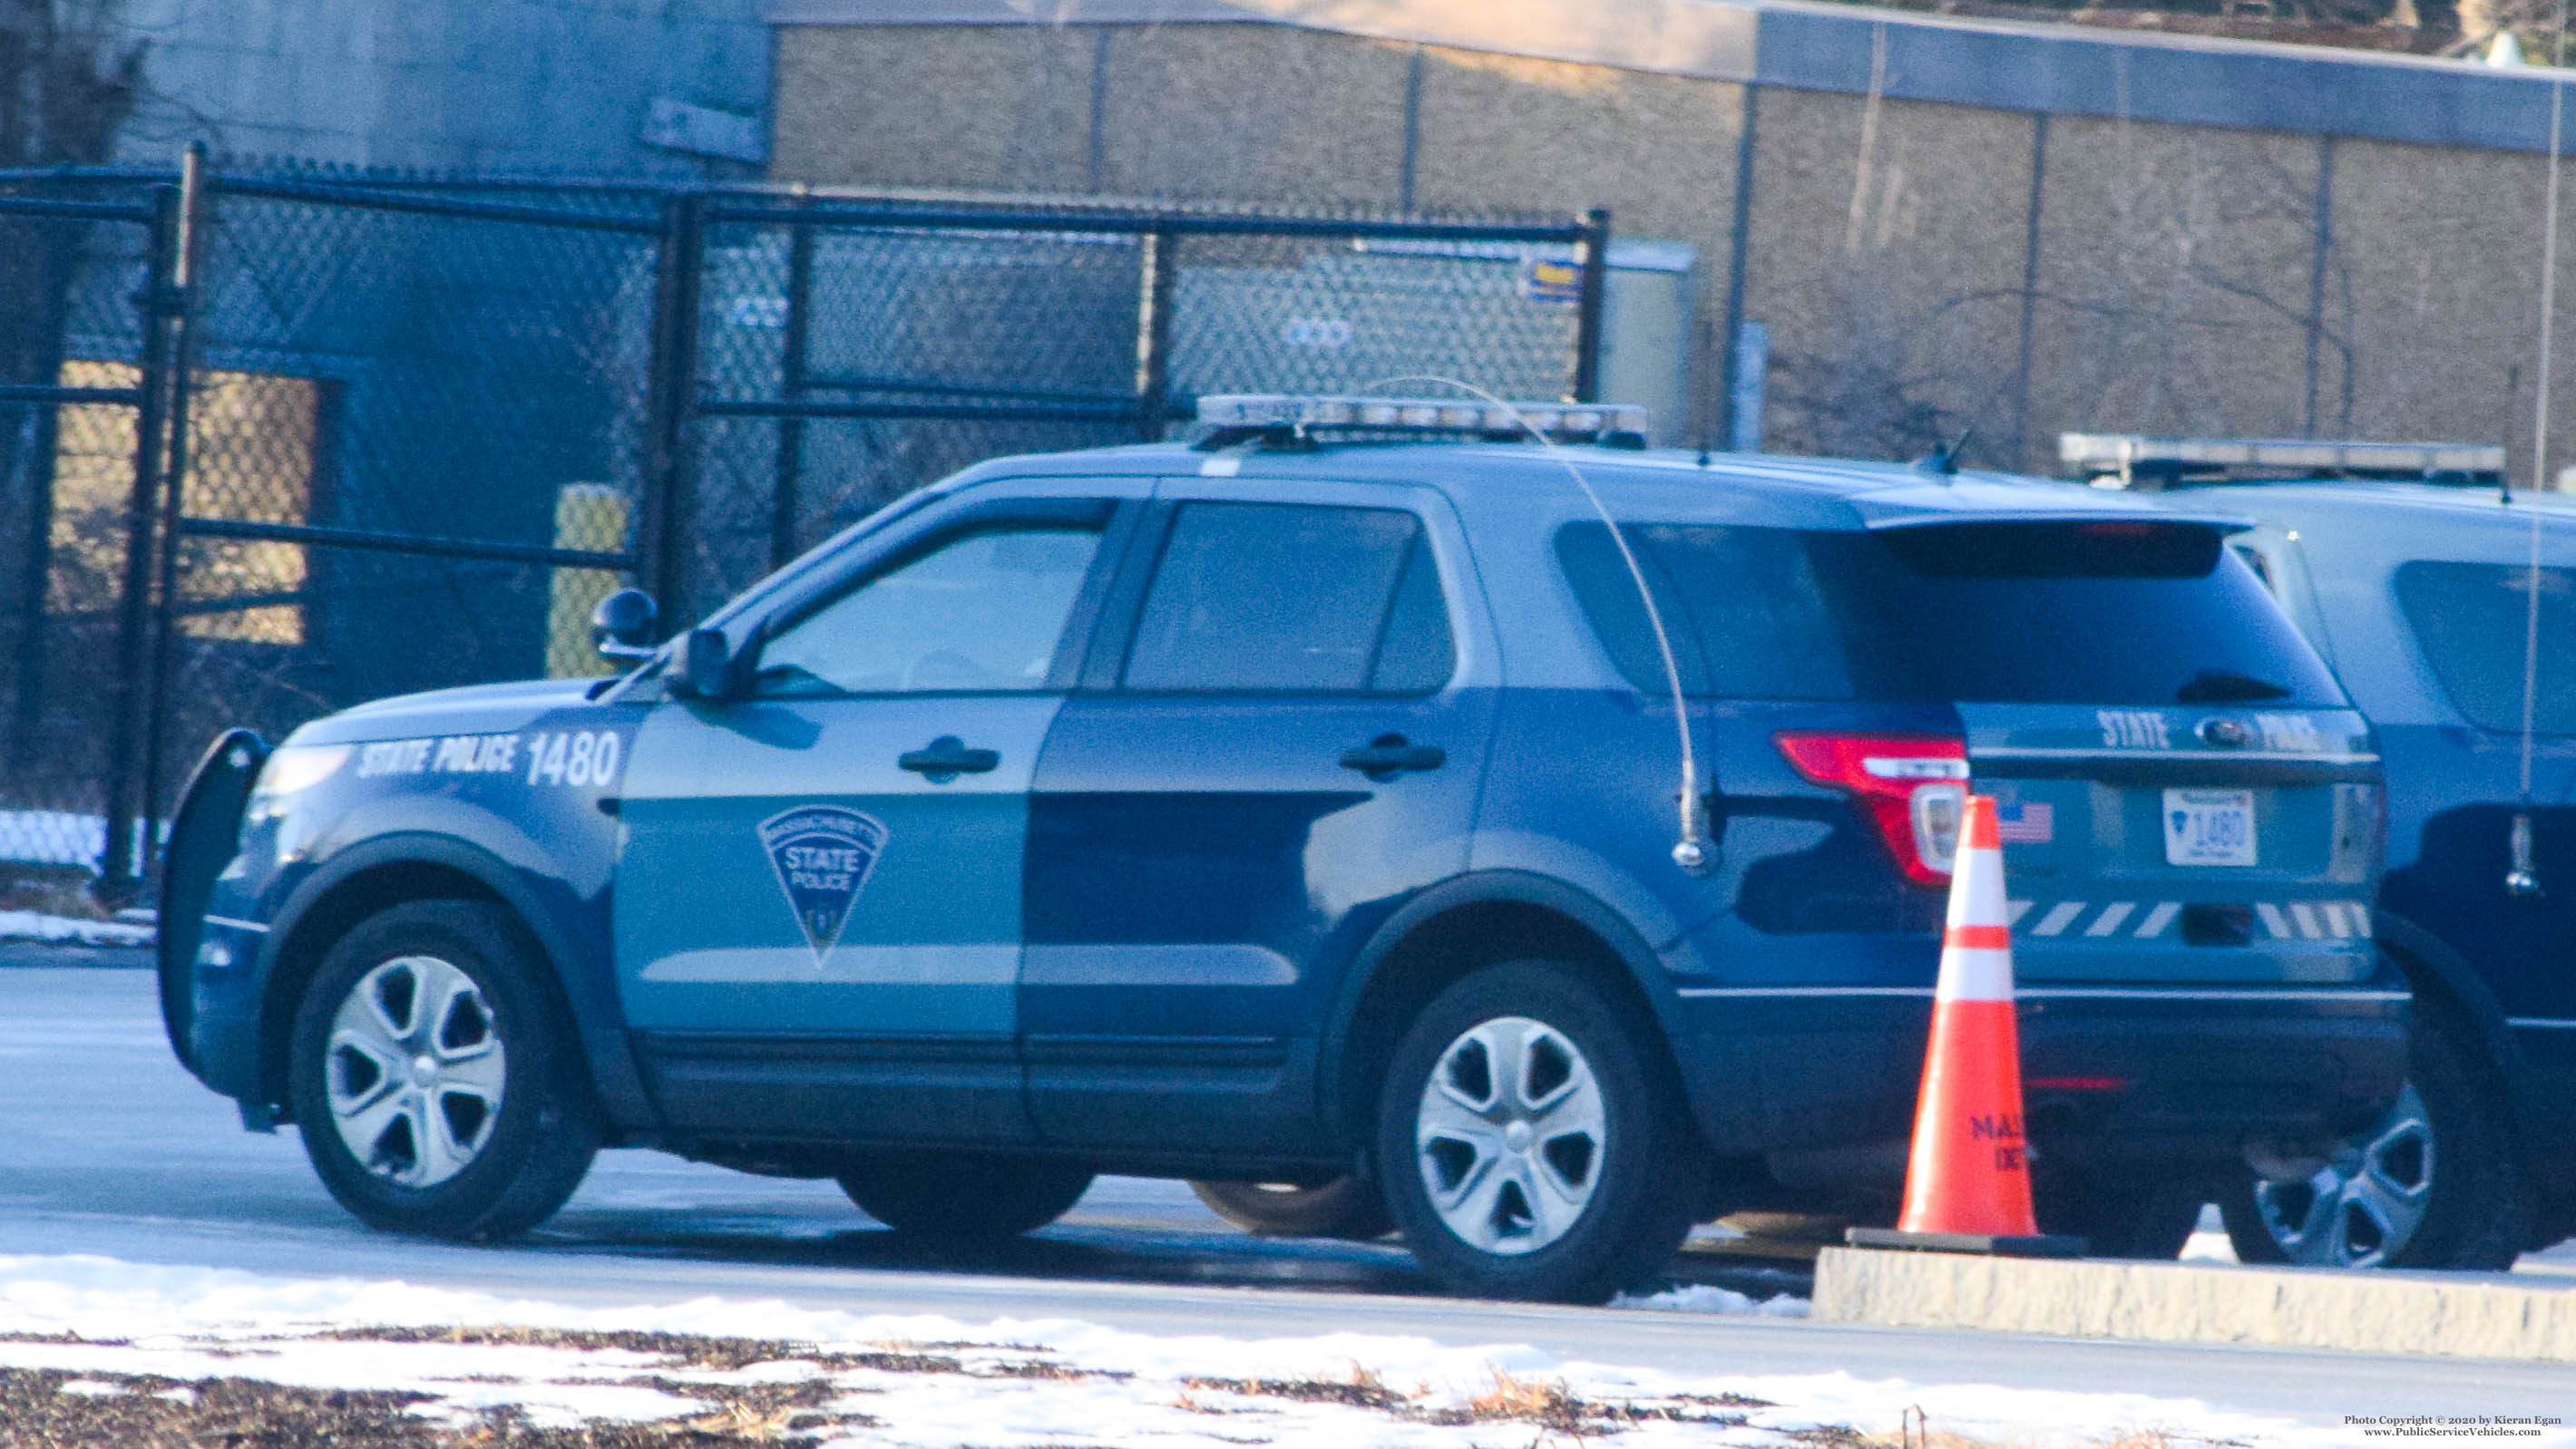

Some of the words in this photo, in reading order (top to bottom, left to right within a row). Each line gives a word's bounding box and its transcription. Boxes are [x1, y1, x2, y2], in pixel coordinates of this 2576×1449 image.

[2097, 711, 2170, 749] STATE
[356, 740, 434, 778] STATE
[432, 734, 521, 773] POLICE
[527, 731, 620, 785] 1480
[2193, 811, 2248, 847] 1480
[785, 846, 861, 872] STATE
[792, 871, 851, 891] POLICE
